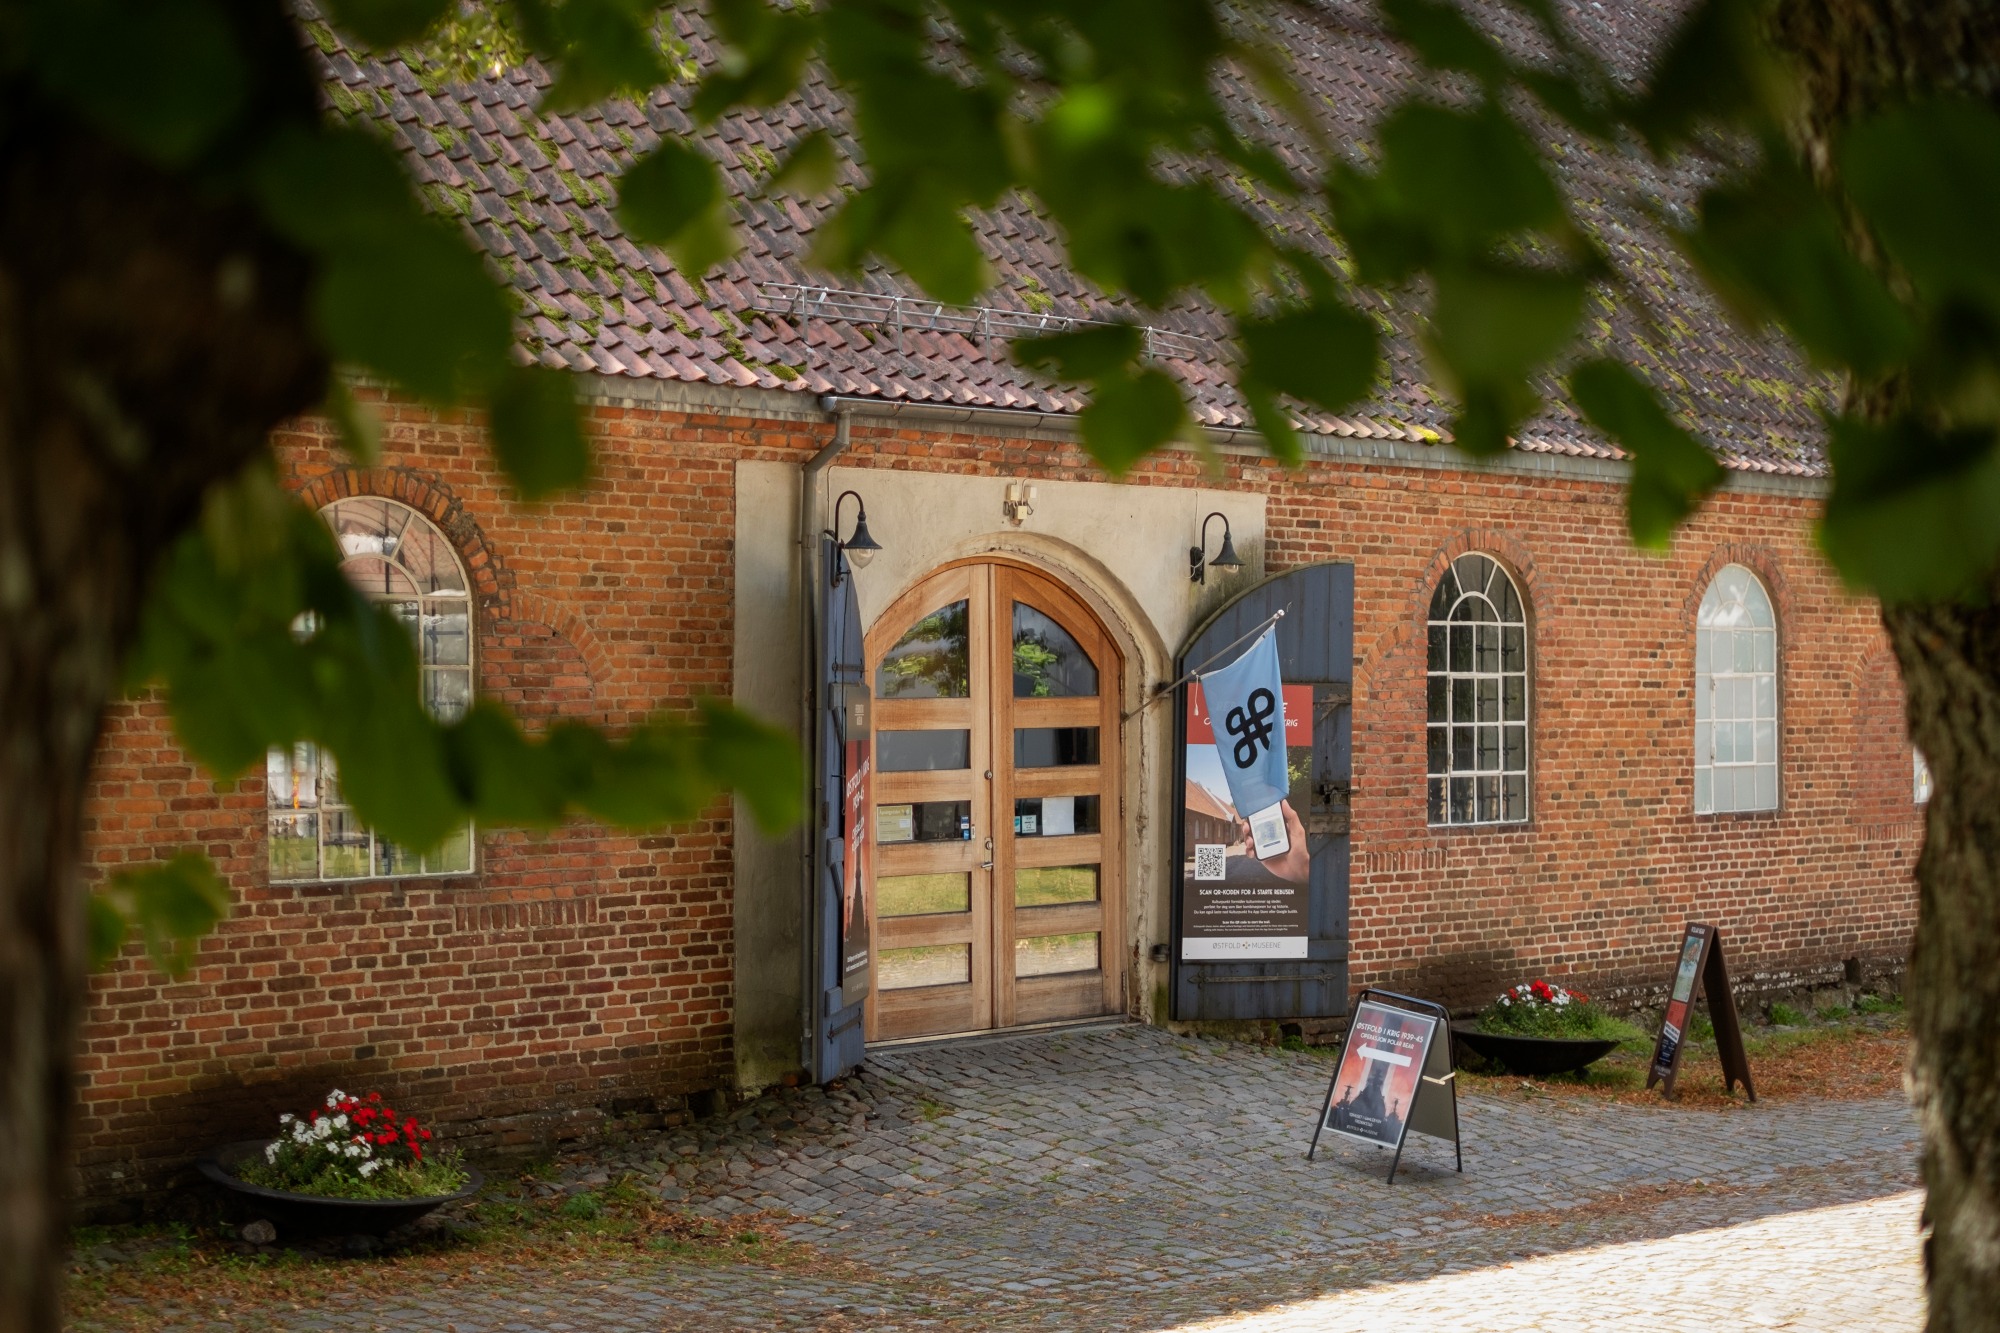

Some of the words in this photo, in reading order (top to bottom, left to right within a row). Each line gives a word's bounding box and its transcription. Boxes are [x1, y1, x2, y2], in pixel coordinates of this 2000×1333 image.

[1251, 941, 1281, 949] MUSEENE
[1356, 1022, 1381, 1034] ØSTFOLD
[1387, 1029, 1400, 1037] KRIG
[1401, 1031, 1424, 1043] 1939-45
[1360, 1032, 1387, 1043] OPERASJON
[1387, 1038, 1402, 1047] POLAR
[1402, 1042, 1415, 1050] BEAR
